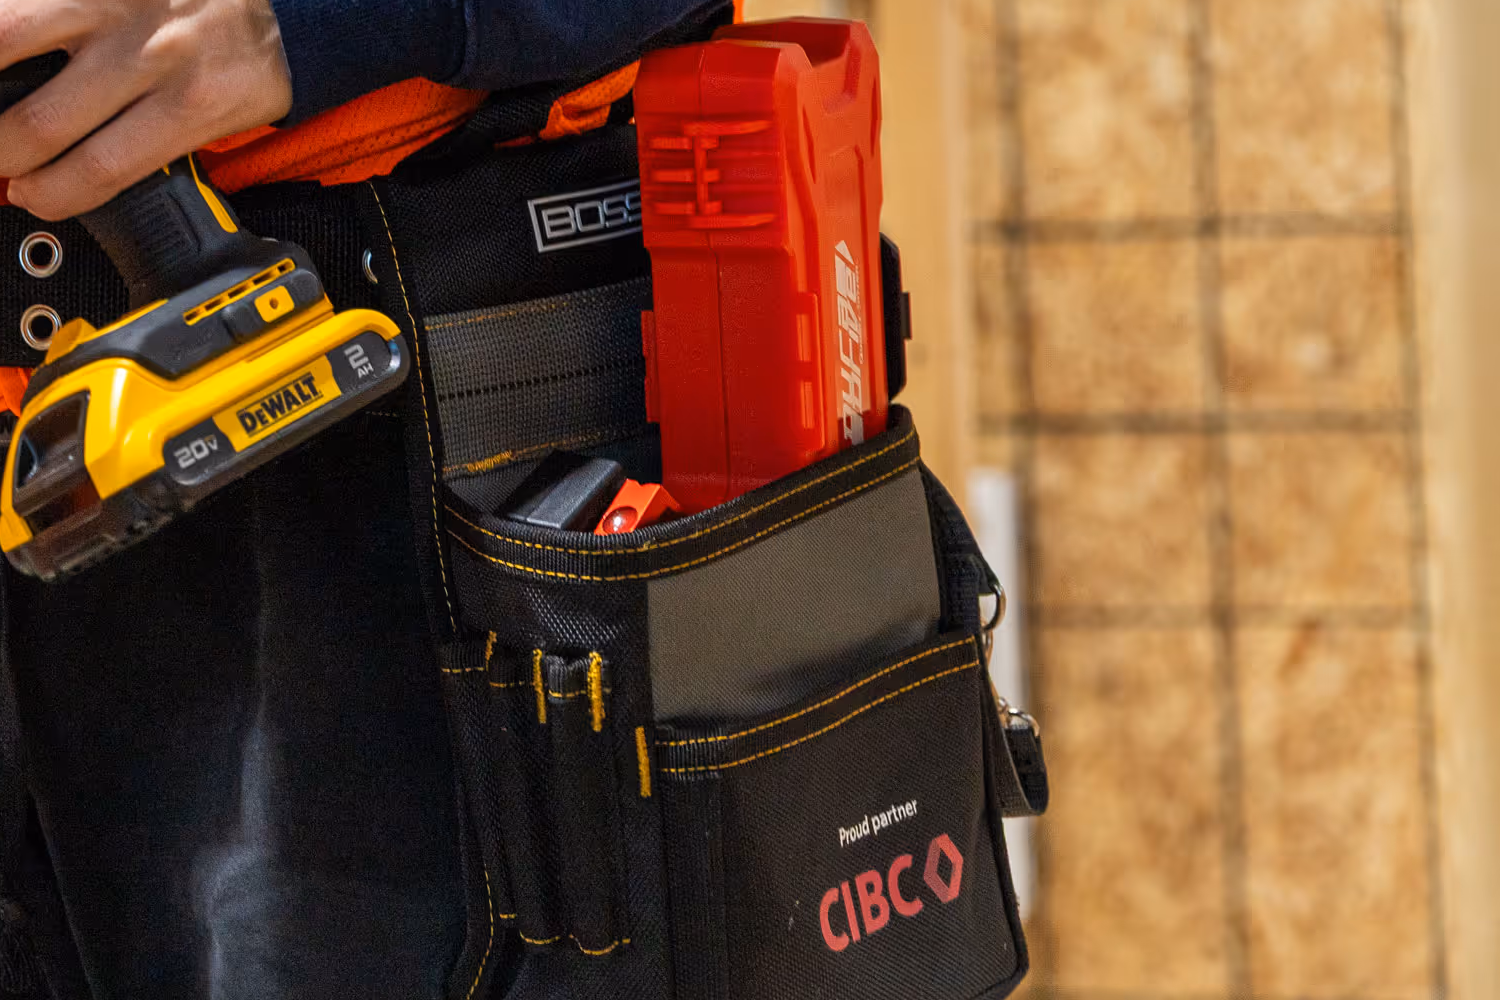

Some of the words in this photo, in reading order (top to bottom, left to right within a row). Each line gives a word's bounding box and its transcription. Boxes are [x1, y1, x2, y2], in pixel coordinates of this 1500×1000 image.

[237, 375, 321, 434] DEWALT
[838, 814, 871, 847] Proud
[871, 800, 918, 835] partner
[820, 854, 924, 952] CIBC
